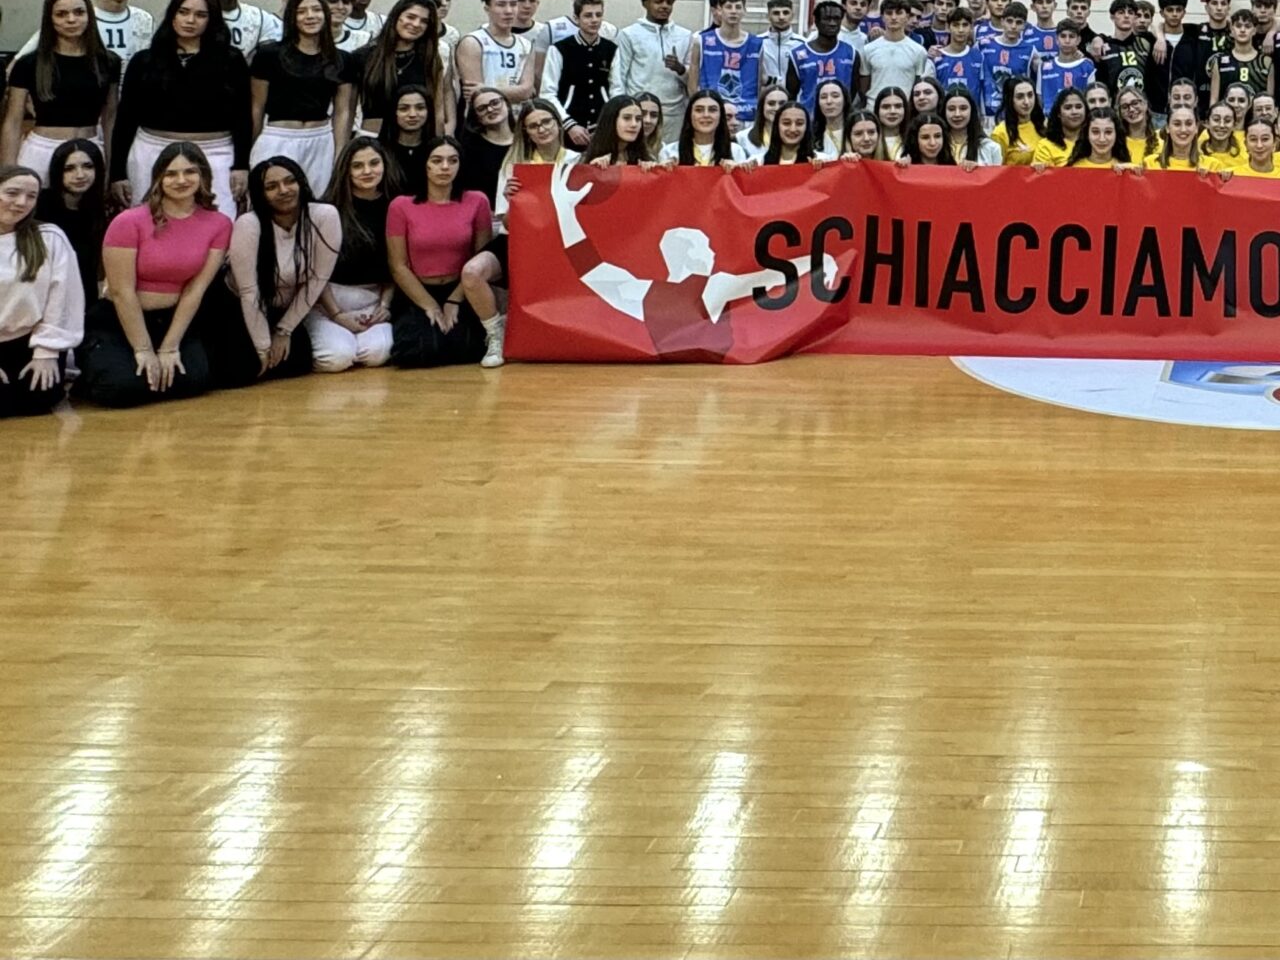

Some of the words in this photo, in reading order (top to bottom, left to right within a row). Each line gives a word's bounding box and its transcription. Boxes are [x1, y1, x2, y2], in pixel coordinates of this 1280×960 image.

[106, 28, 126, 48] 11
[500, 51, 516, 68] 13
[724, 50, 741, 69] 12
[1120, 51, 1137, 66] 12
[817, 59, 836, 75] 14
[953, 61, 964, 77] 4
[1240, 67, 1248, 82] 8
